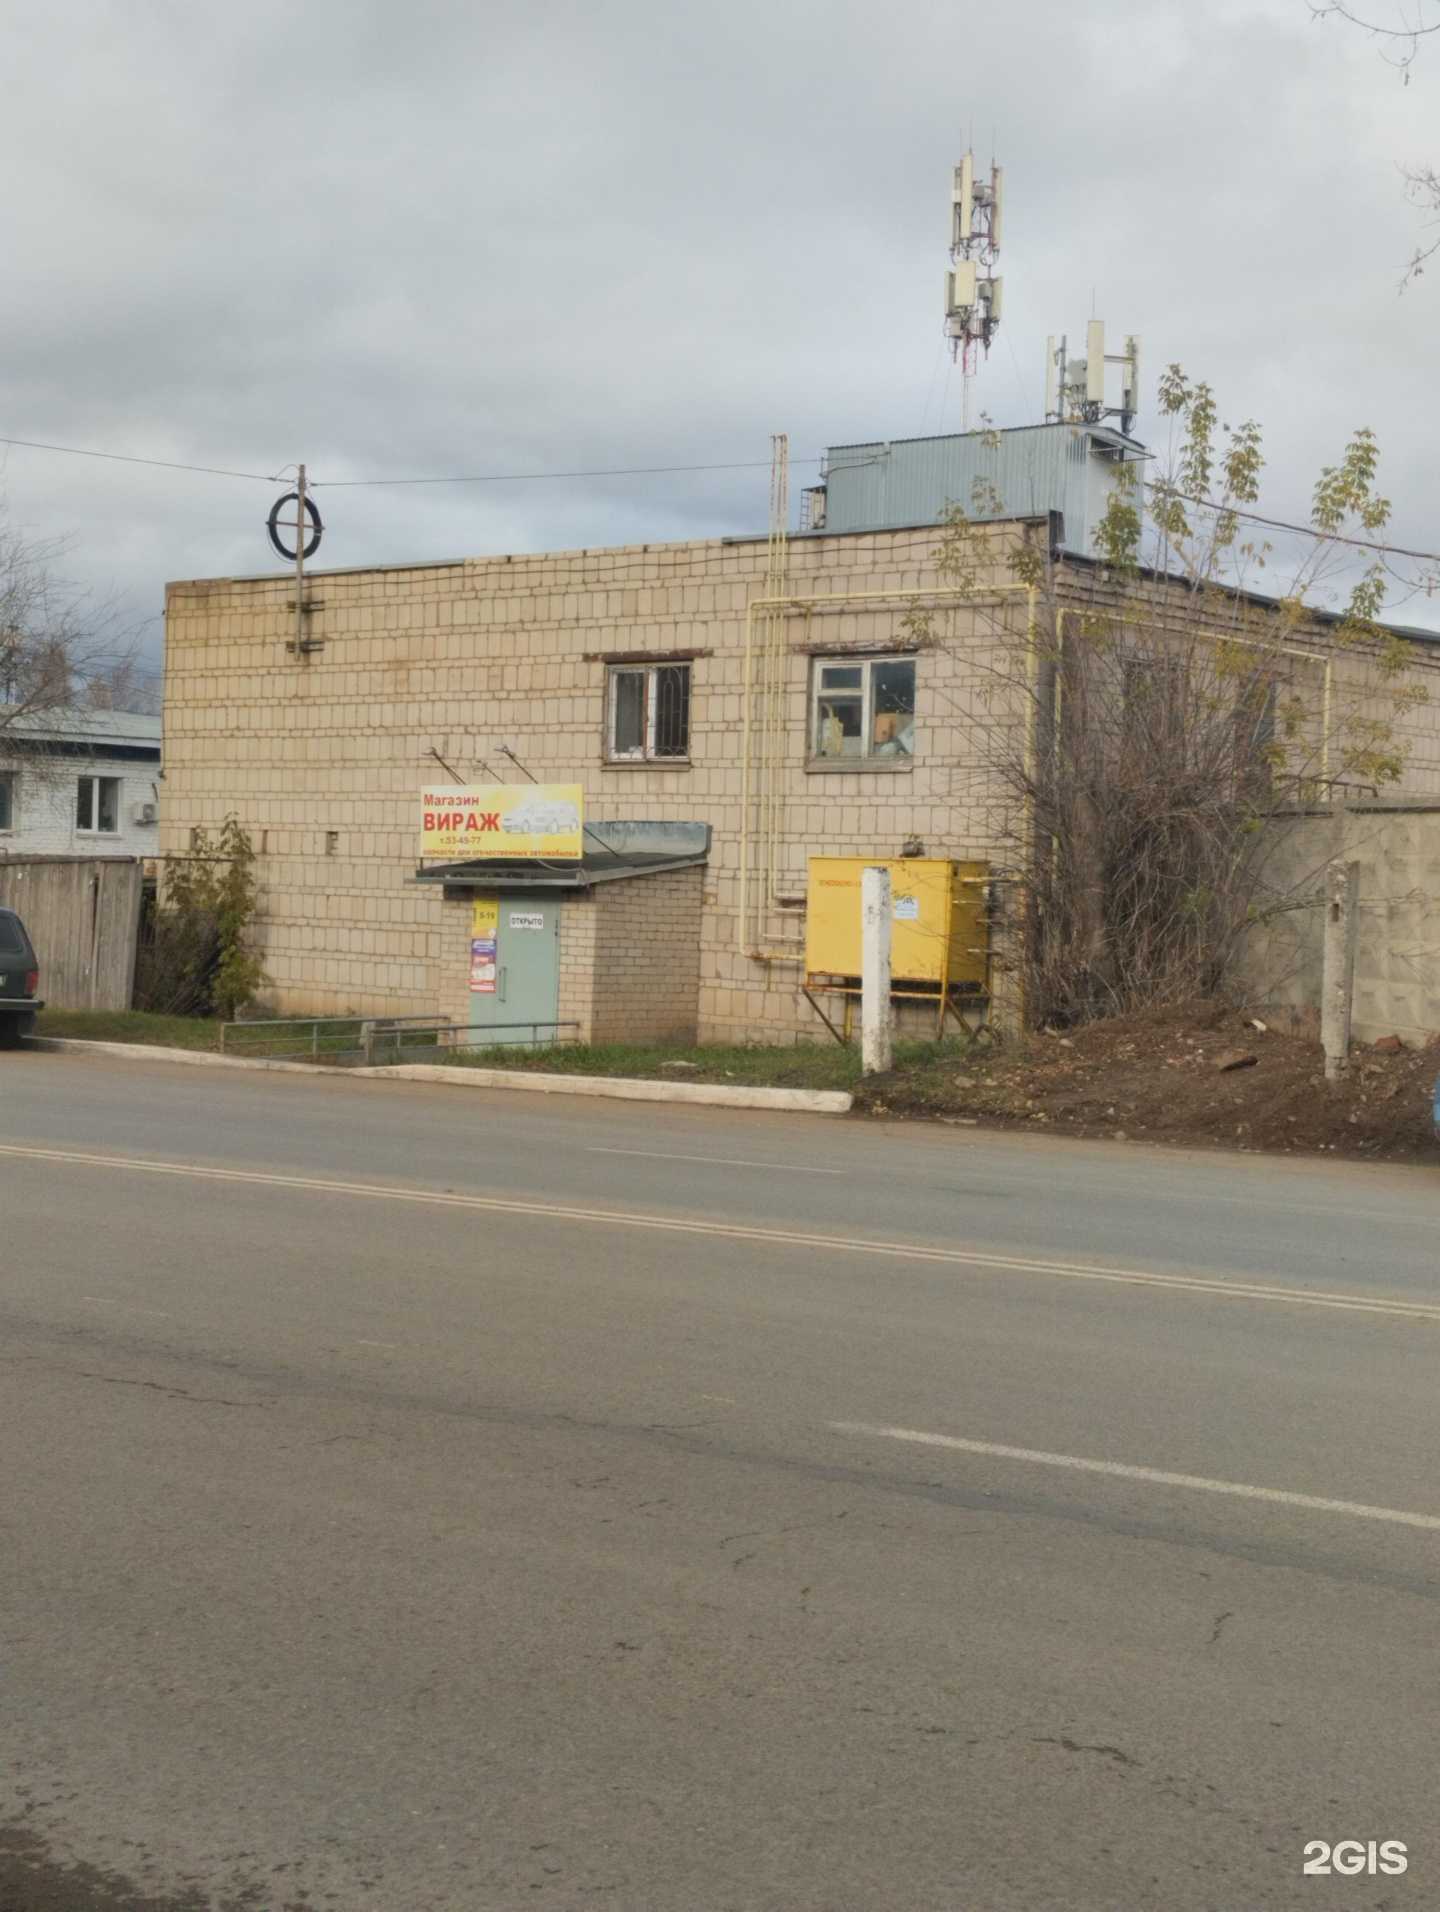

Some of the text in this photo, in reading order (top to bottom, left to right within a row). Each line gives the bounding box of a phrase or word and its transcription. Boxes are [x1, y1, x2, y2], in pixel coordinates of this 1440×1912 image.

[423, 794, 480, 806] Магазин
[423, 813, 501, 832] ВИРАЖ
[511, 917, 543, 926] ОТКРЫТО
